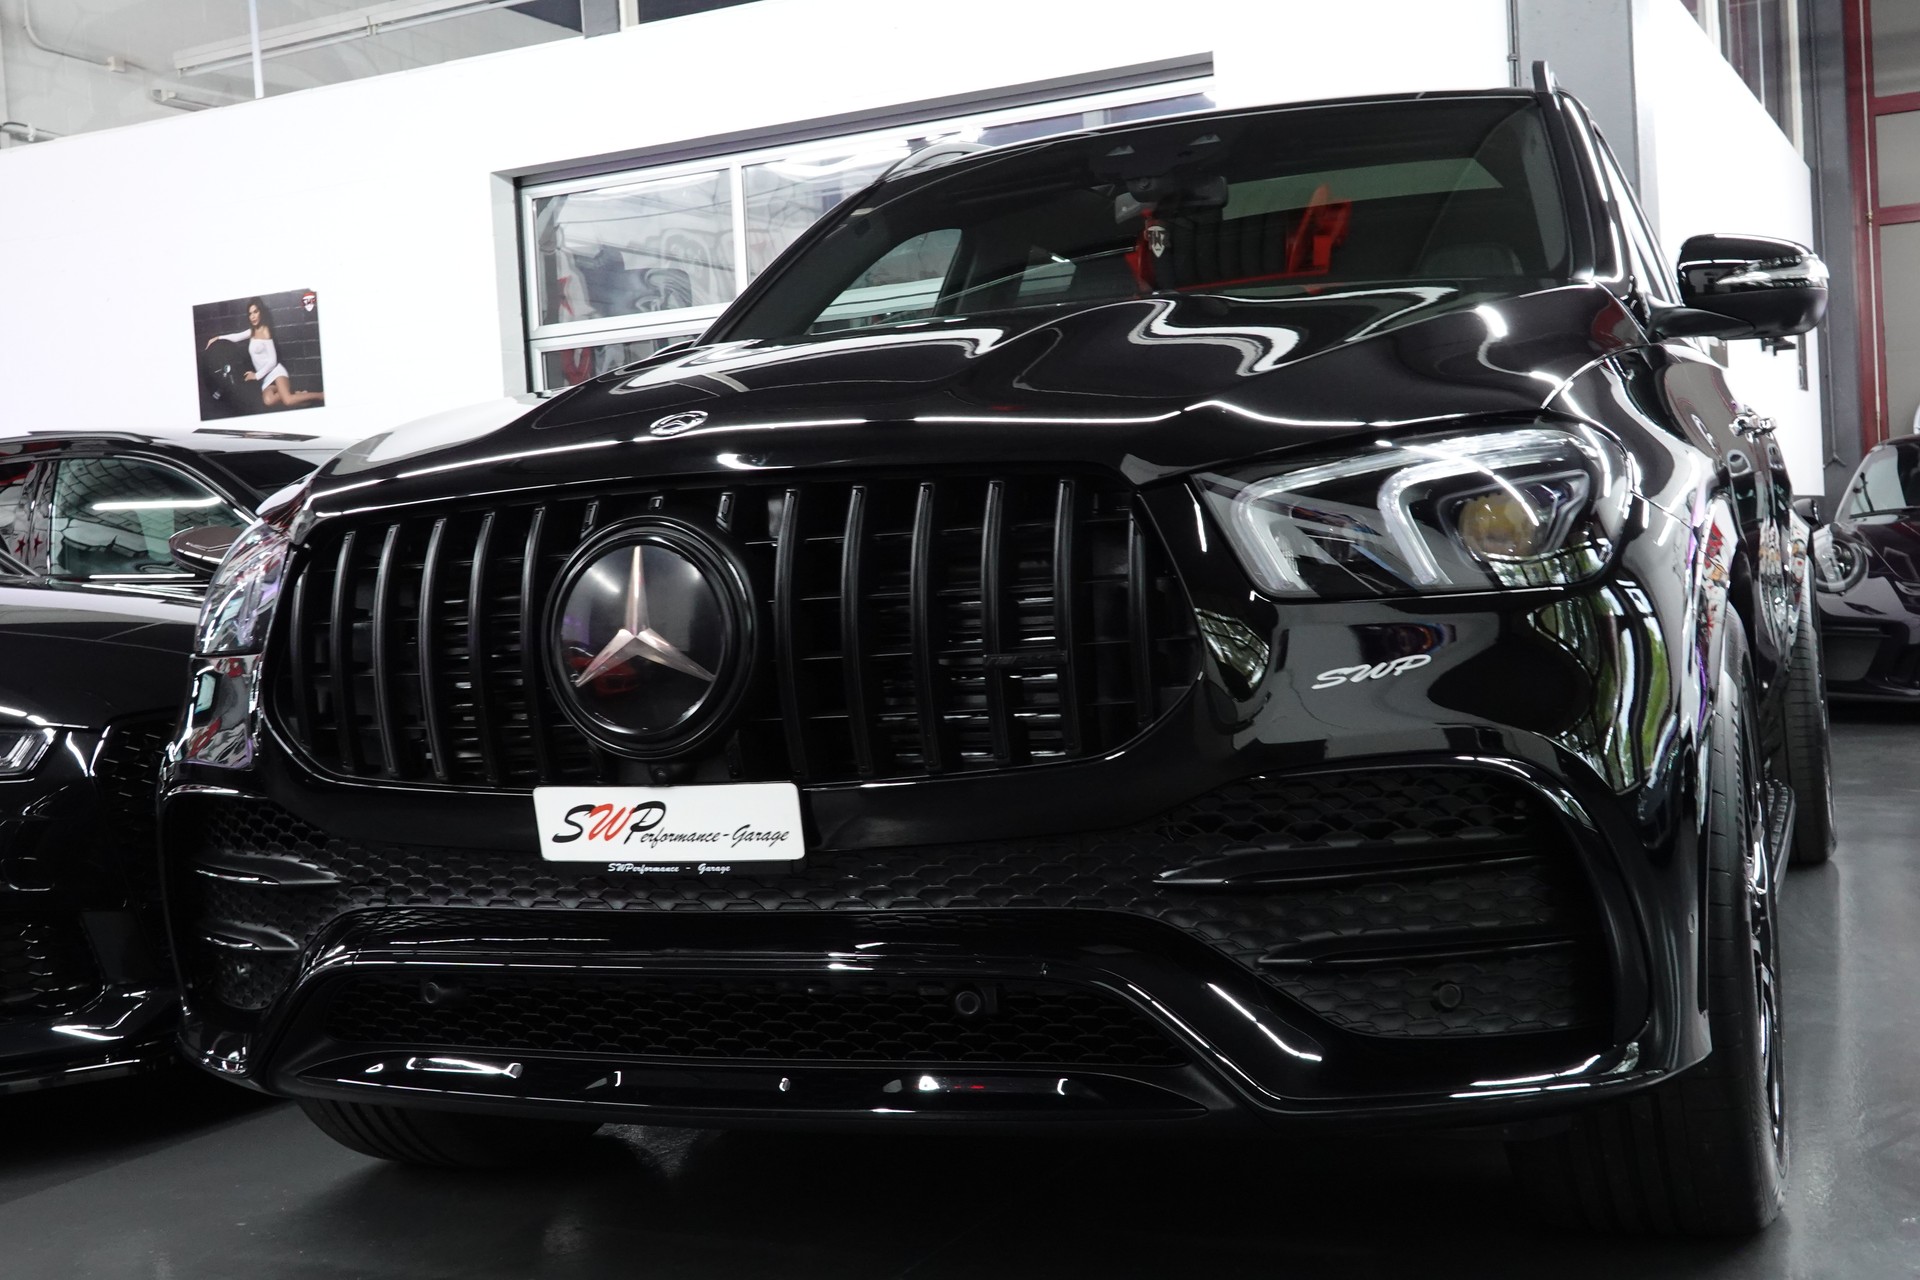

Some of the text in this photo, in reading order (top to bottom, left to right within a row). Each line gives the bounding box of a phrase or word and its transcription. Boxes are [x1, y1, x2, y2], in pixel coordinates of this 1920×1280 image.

[1311, 654, 1432, 690] SWP
[607, 863, 680, 875] SWPerformance
[697, 863, 731, 875] Garage
